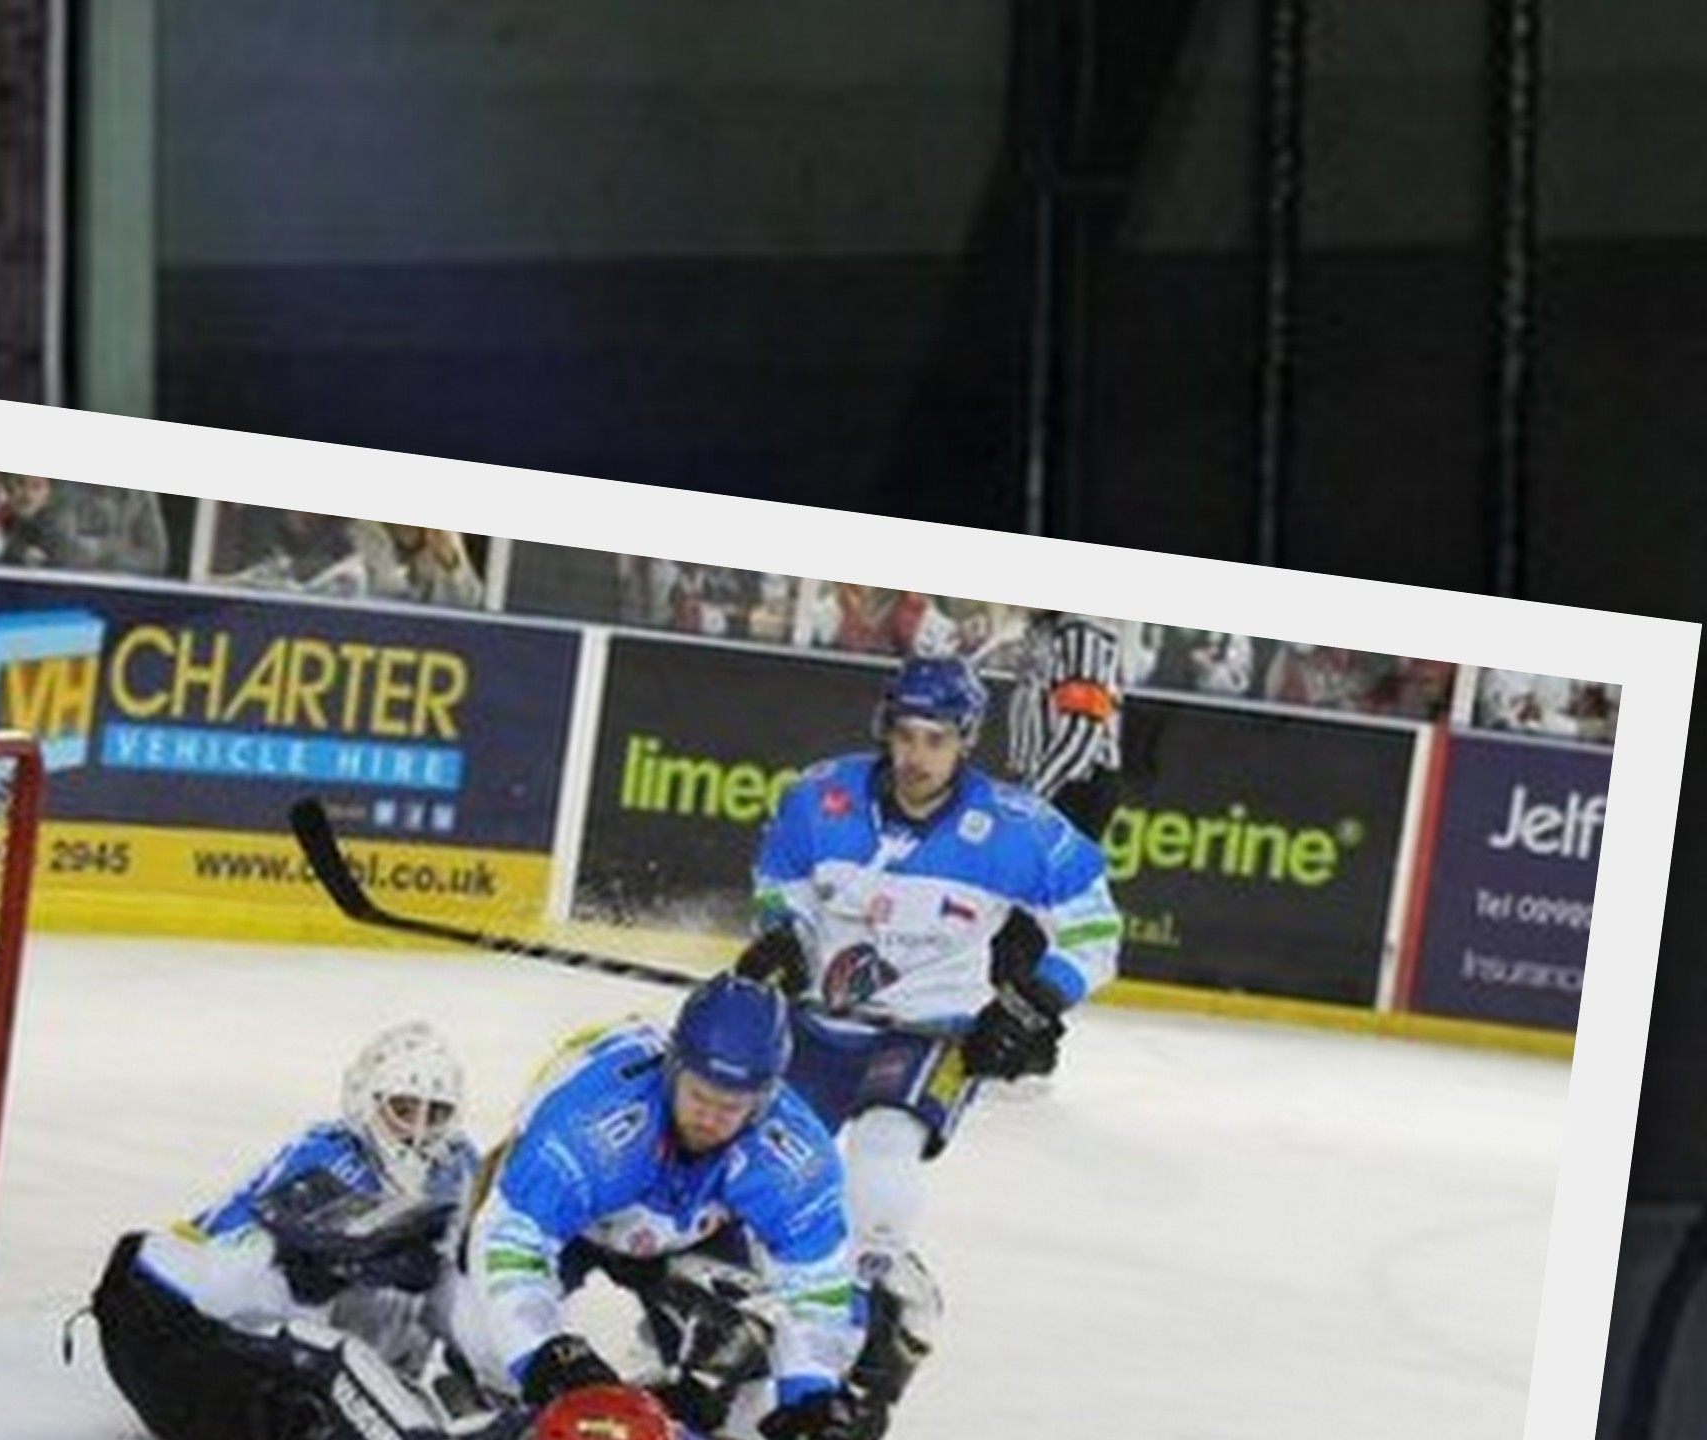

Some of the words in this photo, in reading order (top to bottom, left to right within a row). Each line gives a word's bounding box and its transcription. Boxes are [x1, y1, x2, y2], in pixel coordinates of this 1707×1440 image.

[109, 624, 467, 740] CHARTER
[117, 728, 312, 776] VEHICLE
[337, 744, 453, 786] HIRE
